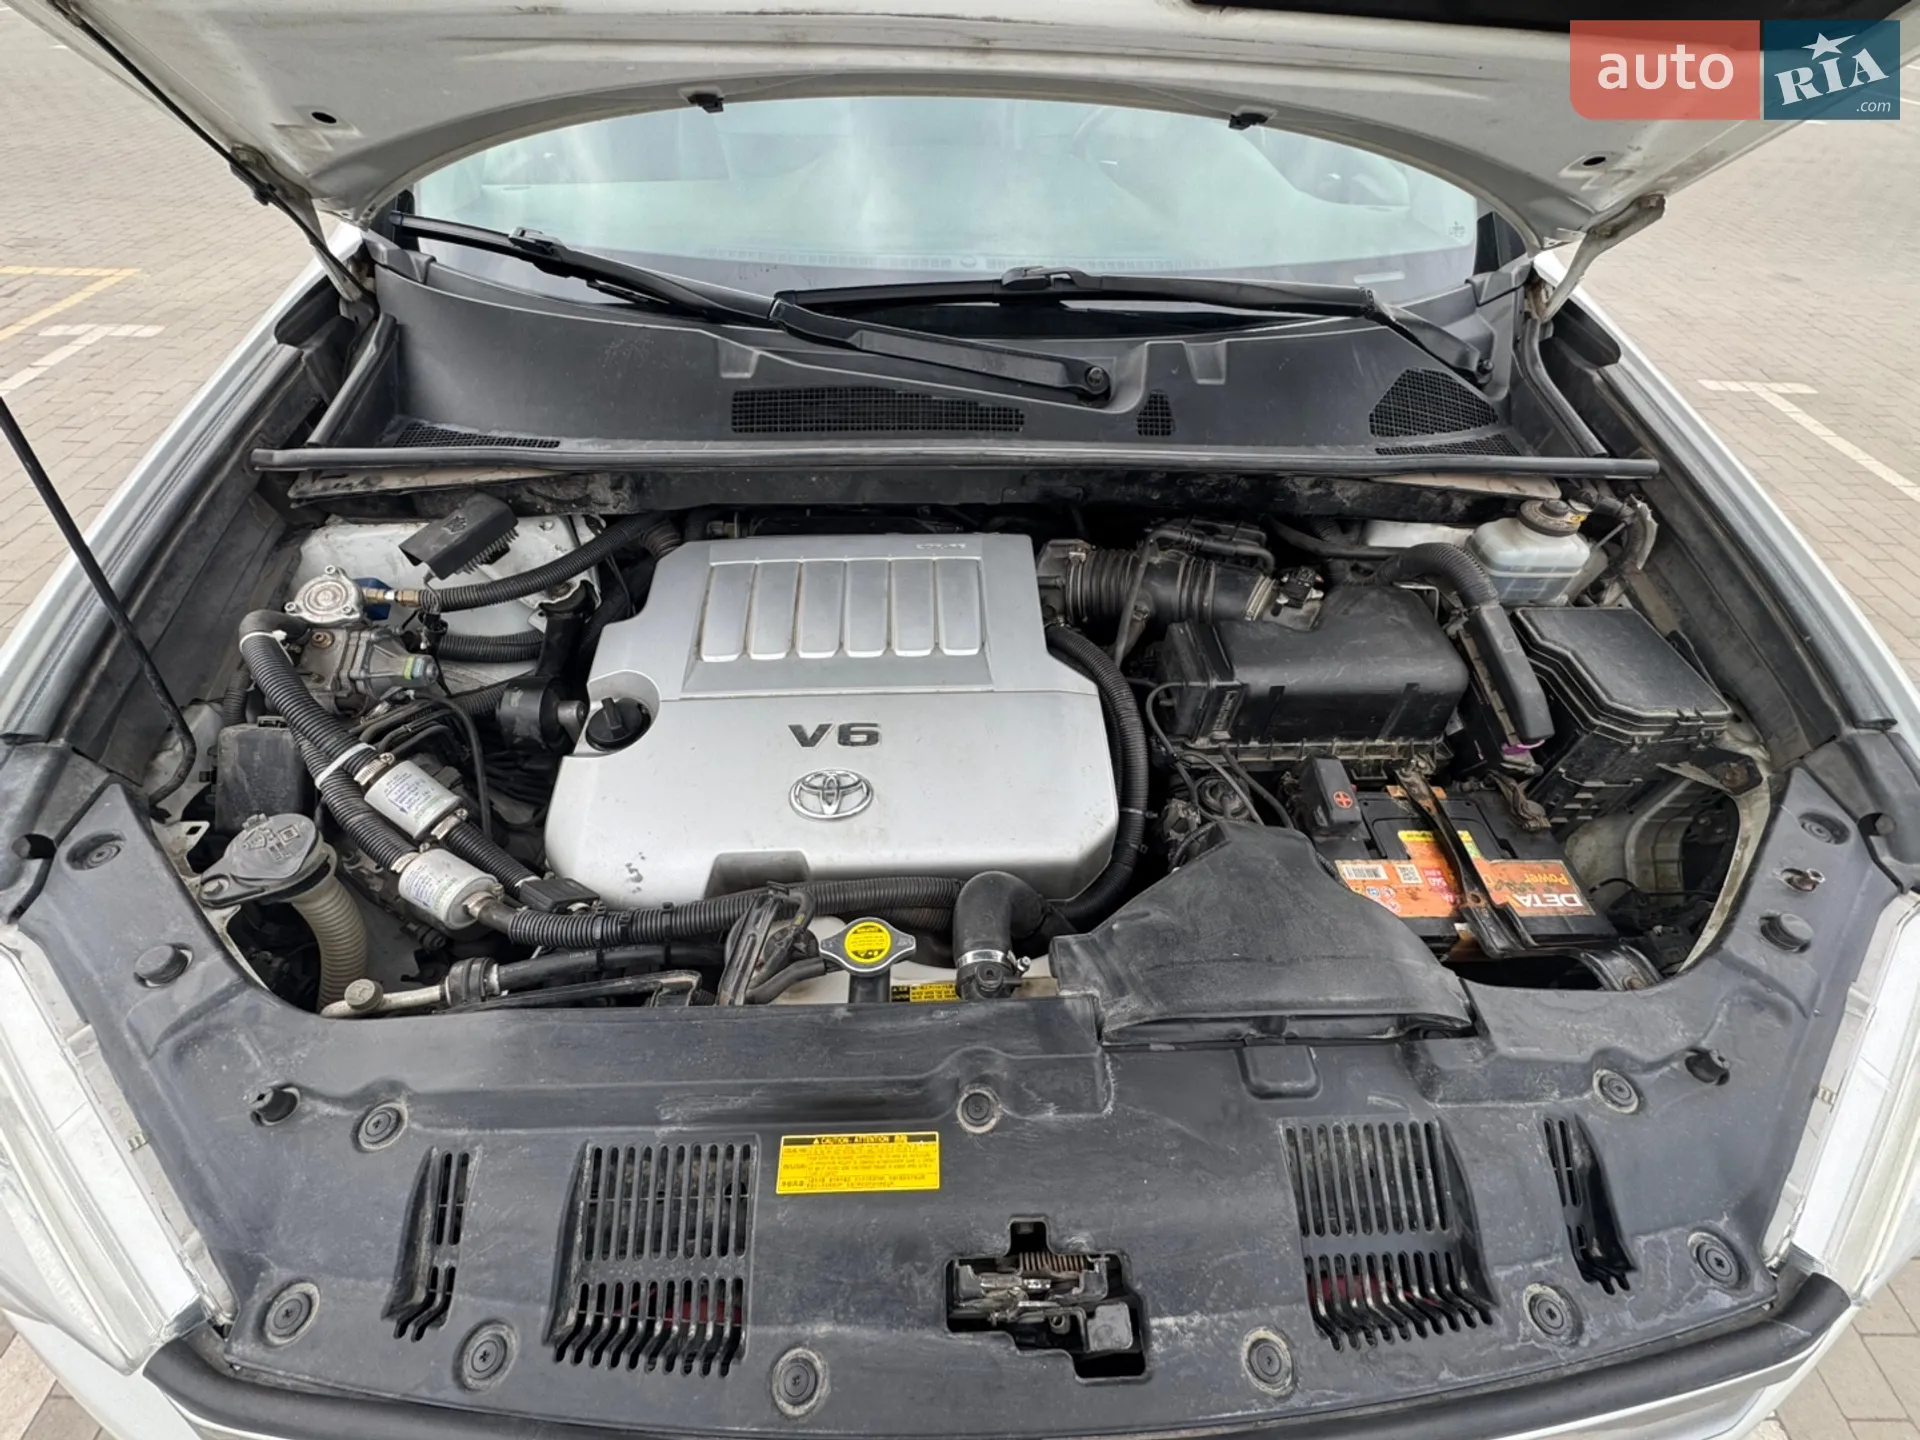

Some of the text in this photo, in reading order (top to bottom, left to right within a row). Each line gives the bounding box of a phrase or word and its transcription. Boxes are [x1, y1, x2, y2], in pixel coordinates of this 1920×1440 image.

[787, 722, 880, 748] V6
[1523, 872, 1569, 886] Power
[1512, 892, 1584, 908] DETA
